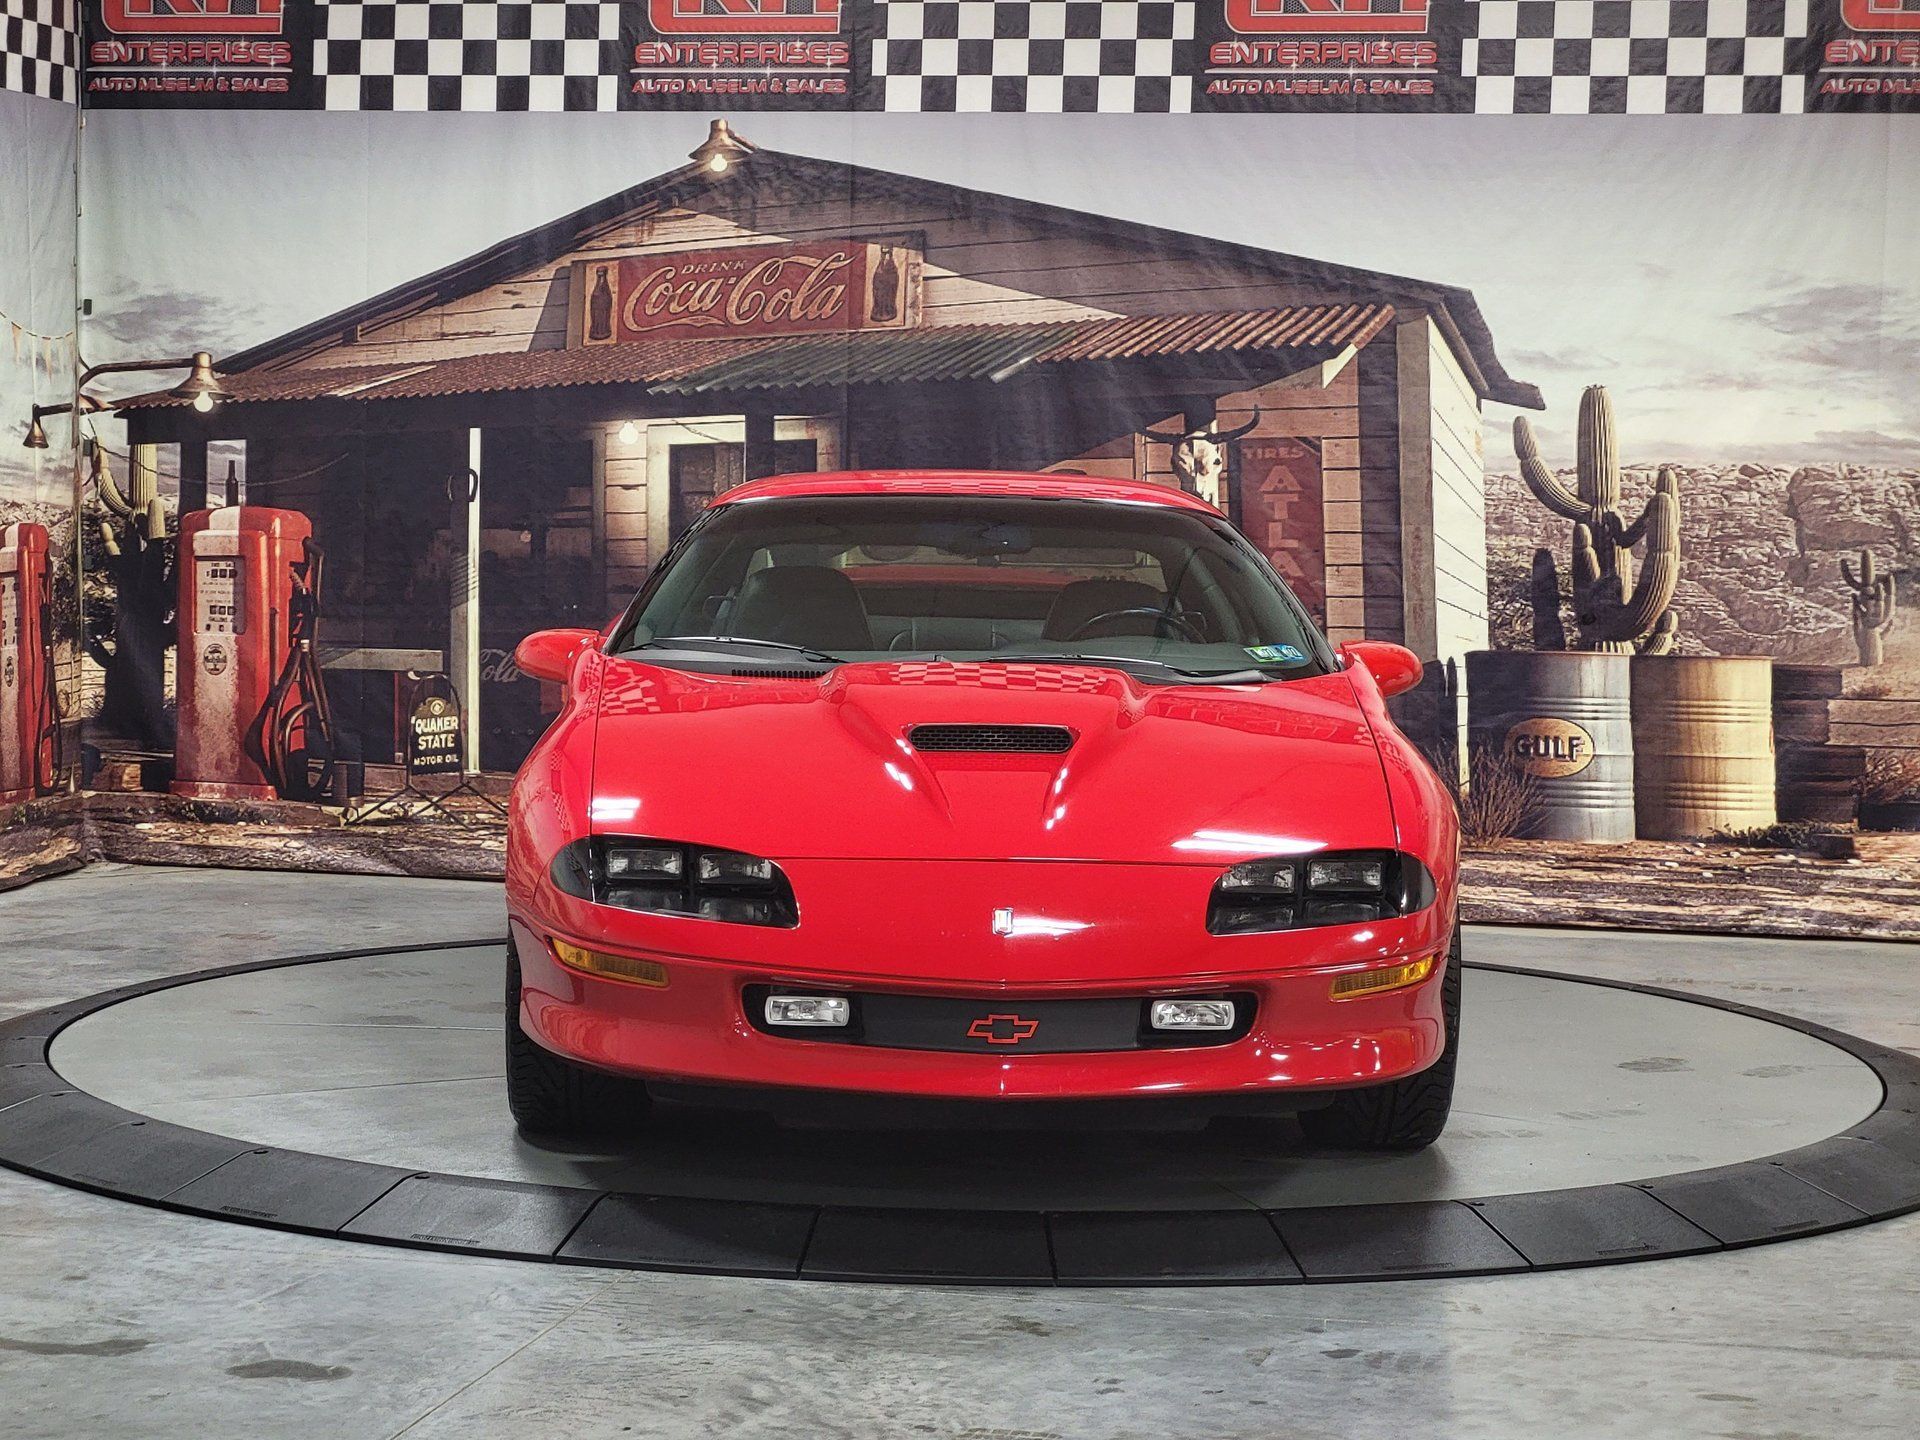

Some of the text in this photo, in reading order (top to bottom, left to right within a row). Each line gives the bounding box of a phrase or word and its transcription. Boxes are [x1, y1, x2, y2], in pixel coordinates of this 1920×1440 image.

[90, 40, 292, 64] ENTERPRISES
[634, 40, 849, 65] ENTERPRISES
[1209, 40, 1438, 65] ENTERPRISES
[1824, 39, 1920, 63] ENTE
[88, 77, 289, 92] AUTO MUSEUM & SALES
[631, 78, 846, 94] AUTO MUSEUM & SALES
[1206, 79, 1435, 95] AUTO MUSEUM & SALES
[1820, 79, 1880, 94] AUTO
[681, 259, 747, 275] DRINK
[1243, 446, 1305, 460] TIRES
[1258, 465, 1305, 587] ATLA
[415, 715, 459, 735] QUAKER
[418, 733, 455, 750] STATE
[1513, 734, 1586, 763] GULF
[413, 754, 459, 766] MOTOR OIL
